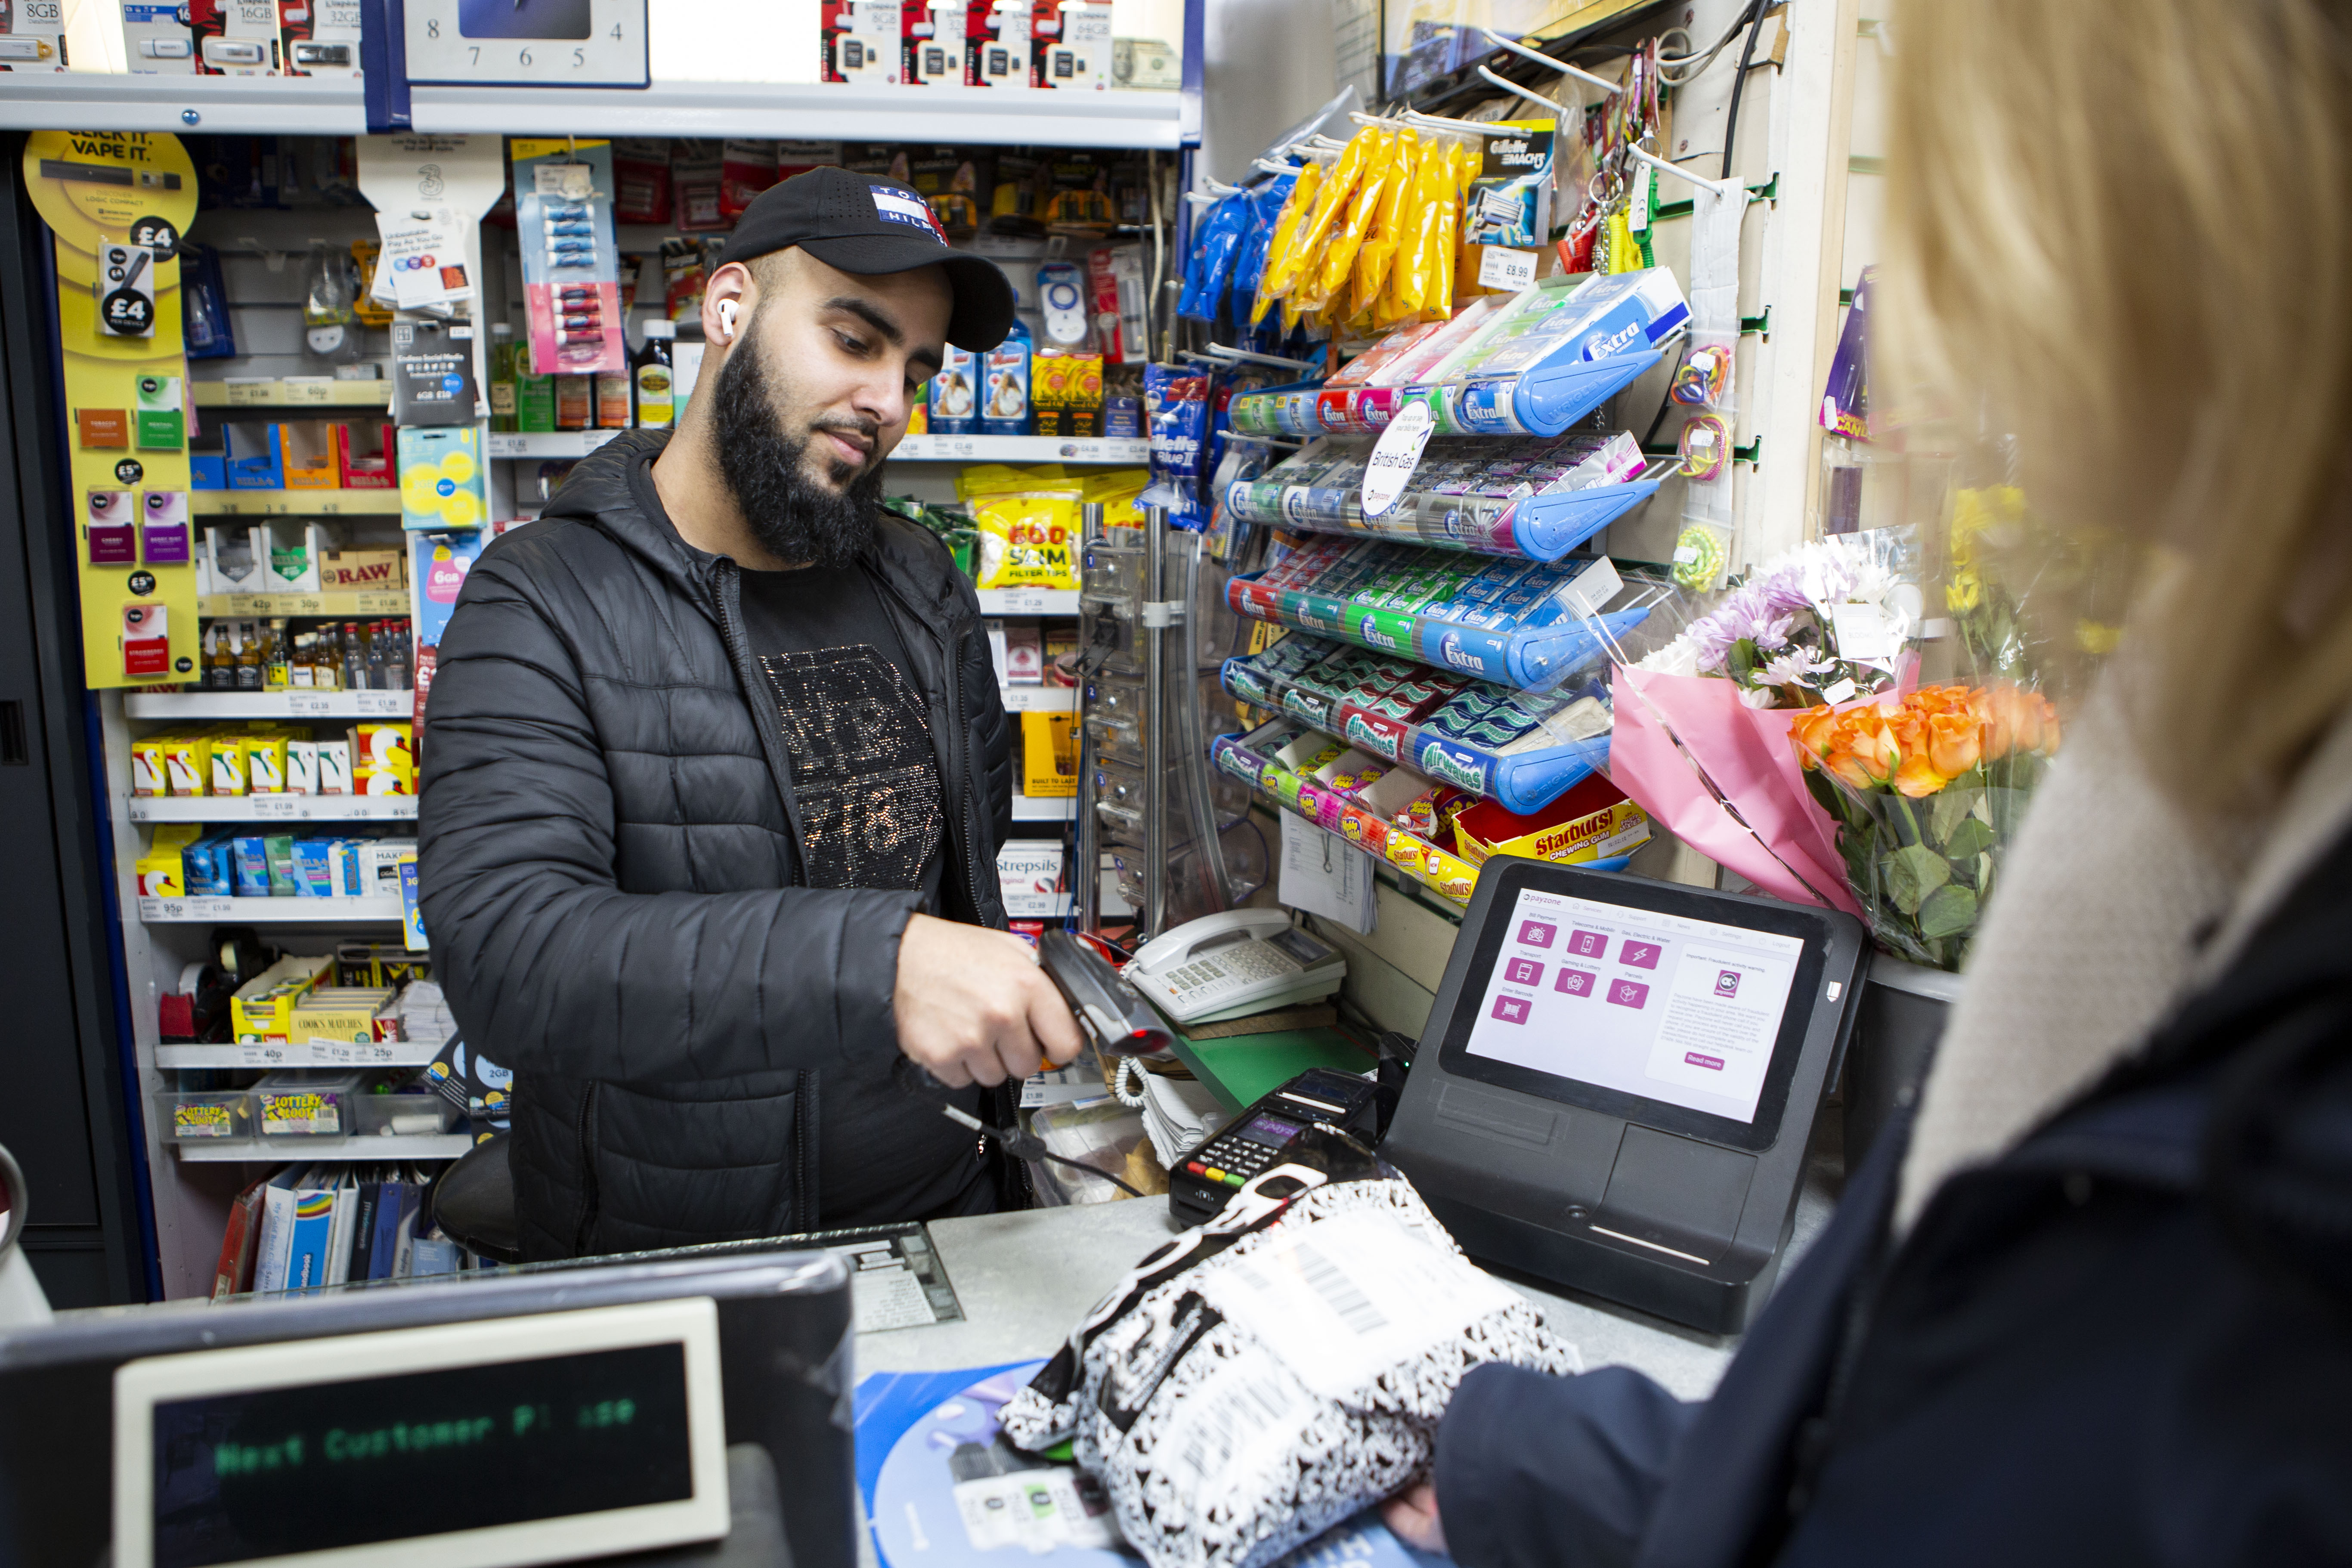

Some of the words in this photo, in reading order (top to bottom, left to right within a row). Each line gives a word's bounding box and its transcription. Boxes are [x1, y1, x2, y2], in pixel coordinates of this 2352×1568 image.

[27, 4, 58, 17] 8GB
[241, 8, 272, 18] 16GB
[872, 12, 897, 23] 8GB
[427, 19, 440, 38] 8
[610, 22, 622, 41] 4
[1077, 23, 1109, 34] 64GB
[468, 46, 481, 66] 7
[520, 47, 532, 66] 6
[573, 48, 585, 68] 5
[71, 139, 124, 158] VAPE
[130, 146, 151, 161] IT.
[1490, 139, 1528, 155] Gillette
[1507, 153, 1545, 169] MACH3
[86, 196, 108, 204] LOGIC
[139, 226, 172, 248] £4
[387, 239, 402, 248] Pay
[1514, 231, 1522, 243] 4
[389, 246, 409, 255] rates
[1506, 264, 1528, 278] £8.99
[111, 298, 145, 320] £4
[1429, 306, 1436, 315] 5
[1539, 316, 1577, 329] Extra
[1588, 321, 1640, 361] Extra
[1324, 405, 1346, 422] Extra
[1365, 405, 1389, 421] Extra
[1466, 402, 1496, 420] Extra
[1157, 452, 1183, 463] Blue
[1373, 451, 1399, 468] British
[1399, 453, 1414, 469] Gas
[1373, 493, 1390, 501] payzone
[1293, 499, 1317, 520] Extra
[1008, 524, 1065, 544] 600
[1448, 519, 1476, 537] Extra
[1009, 548, 1066, 566] SLIM
[336, 562, 393, 584] RAW
[434, 571, 459, 584] 6GB
[1467, 586, 1488, 596] Extra
[1242, 594, 1266, 615] Extra
[1357, 593, 1375, 603] Extra
[1390, 597, 1409, 607] Extra
[1507, 593, 1530, 603] Extra
[1426, 605, 1448, 615] Extra
[1464, 610, 1488, 622] Extra
[1299, 607, 1325, 631] Extra
[1364, 622, 1396, 649] Extra
[1445, 641, 1484, 670] Extra
[1285, 692, 1325, 728] Airwaves
[1348, 715, 1394, 755] Airwaves
[1221, 750, 1256, 784] Airwaves
[1424, 743, 1481, 789] Airwaves
[1343, 819, 1358, 832] Hubba
[1619, 817, 1642, 833] MIXIES
[1621, 813, 1638, 826] FRUITY
[1535, 808, 1613, 856] Starburst
[1550, 840, 1590, 860] CHEWING
[1591, 831, 1610, 844] GUM
[1394, 849, 1419, 860] Starburst
[996, 859, 1058, 875] Strepsils
[1440, 881, 1472, 896] Starburst
[164, 904, 183, 913] 95p
[1530, 895, 1561, 906] payzone
[1628, 913, 1646, 922] Support
[1722, 932, 1742, 940] Settings
[1537, 913, 1557, 922] Payment
[1572, 920, 1594, 929] Telecoms
[1520, 950, 1541, 959] Transport
[1562, 959, 1579, 968] Gaming
[1585, 964, 1600, 972] Lottery
[1708, 958, 1730, 966] Fraudulent
[1625, 971, 1643, 980] Parcels
[1515, 989, 1534, 998] Barcode
[298, 1019, 326, 1029] COOK'S
[328, 1019, 362, 1029] MATCHES
[264, 1049, 282, 1059] 40p
[374, 1048, 392, 1058] 25p
[1688, 1055, 1704, 1064] Read
[1705, 1059, 1721, 1067] more
[489, 1069, 508, 1077] 2GB
[275, 1095, 320, 1107] LOTTERY
[282, 1107, 313, 1118] LOOT
[215, 1434, 303, 1477] Next
[325, 1414, 493, 1461] Customer
